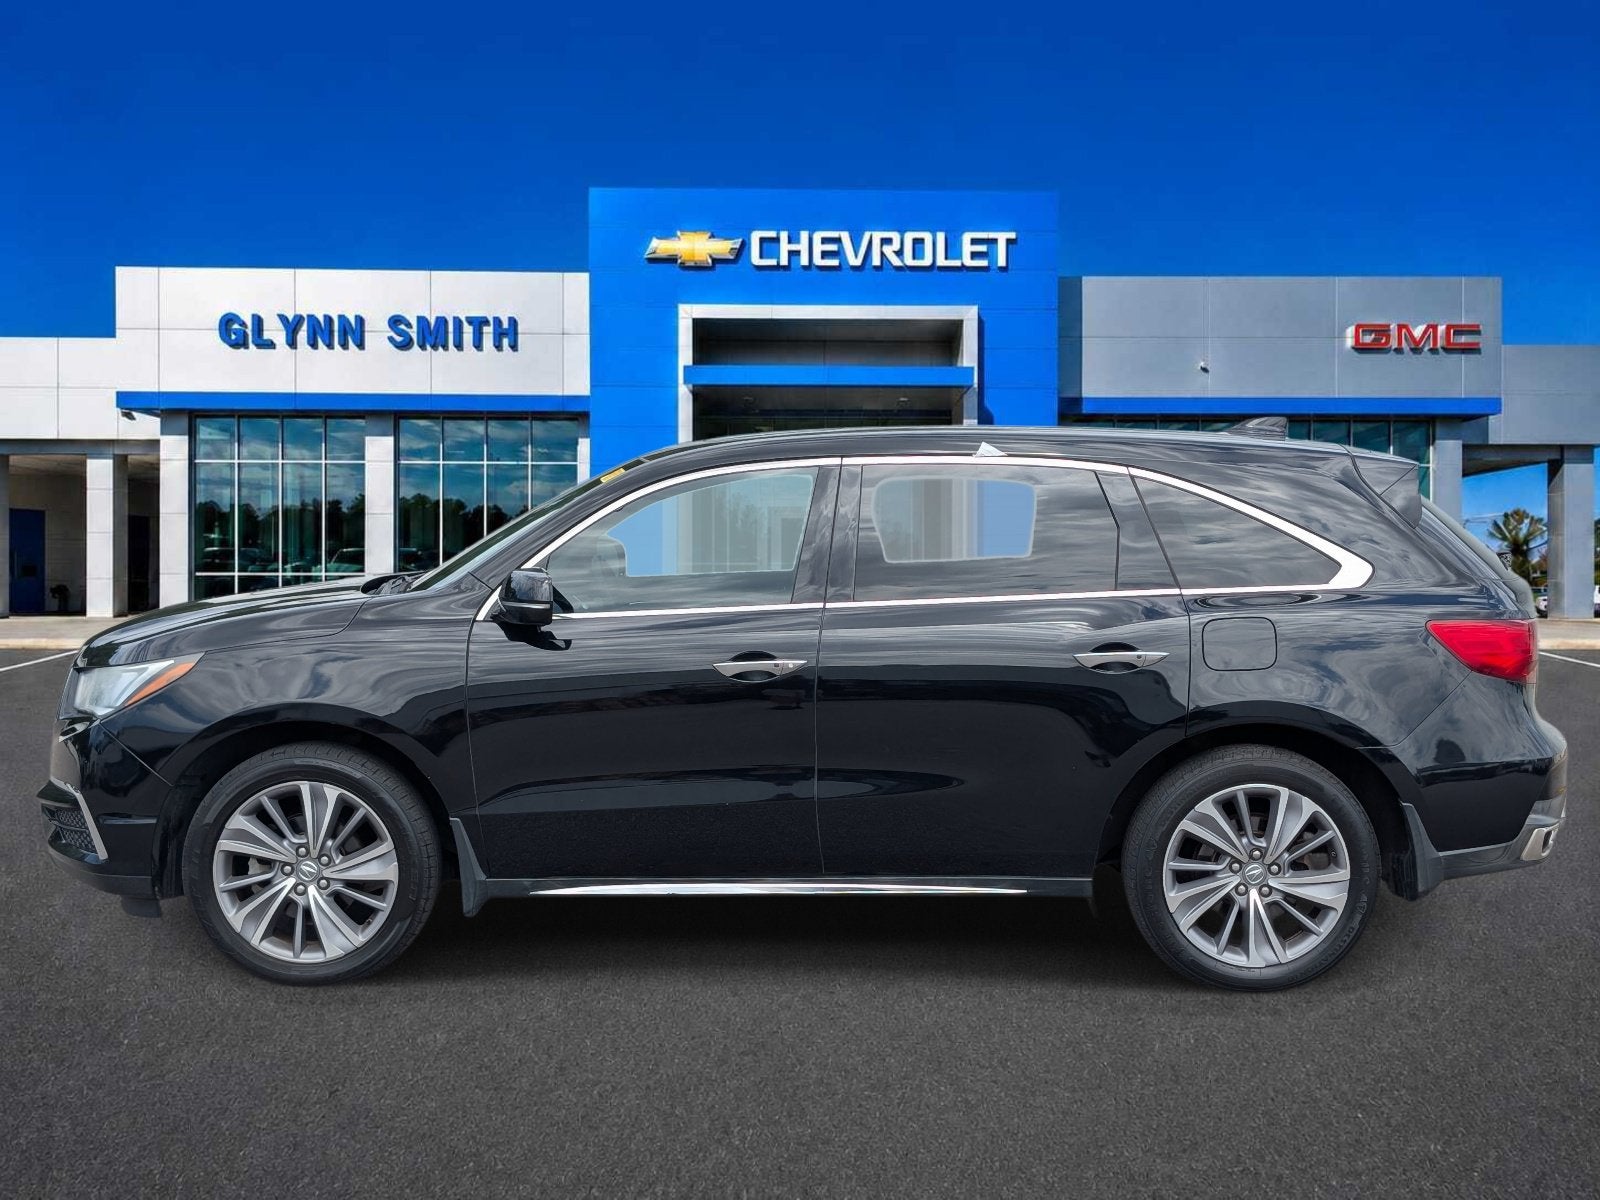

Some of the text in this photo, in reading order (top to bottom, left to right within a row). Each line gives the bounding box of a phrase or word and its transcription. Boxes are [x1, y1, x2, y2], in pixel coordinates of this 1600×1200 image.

[751, 230, 1017, 268] CHEVROLET
[218, 312, 519, 352] GLYNN SMITH
[1351, 323, 1481, 351] GMC
